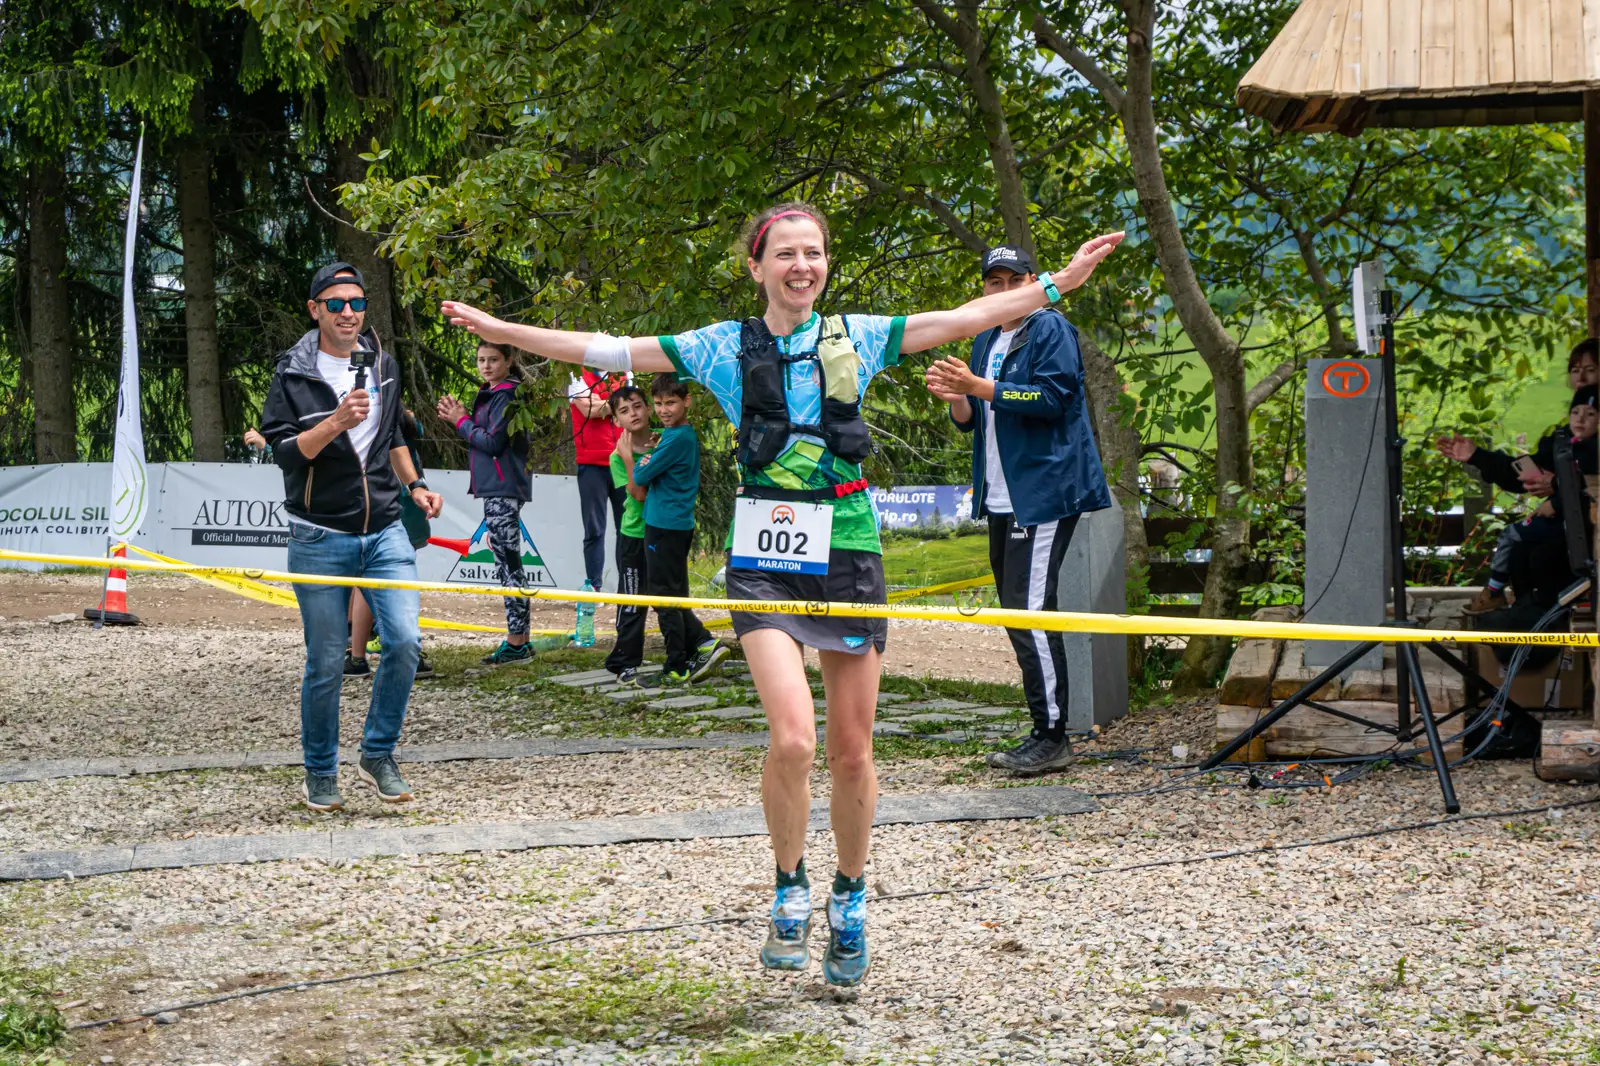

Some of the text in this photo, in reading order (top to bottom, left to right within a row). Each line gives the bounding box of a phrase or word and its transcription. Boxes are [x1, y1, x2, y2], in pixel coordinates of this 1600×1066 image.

[192, 499, 289, 527] AUTOK
[0, 525, 39, 536] IHUTA
[202, 532, 233, 543] Official
[235, 534, 259, 543] home
[261, 534, 271, 544] of
[758, 528, 809, 556] 002
[757, 560, 802, 571] MARATON
[459, 565, 543, 582] salvant
